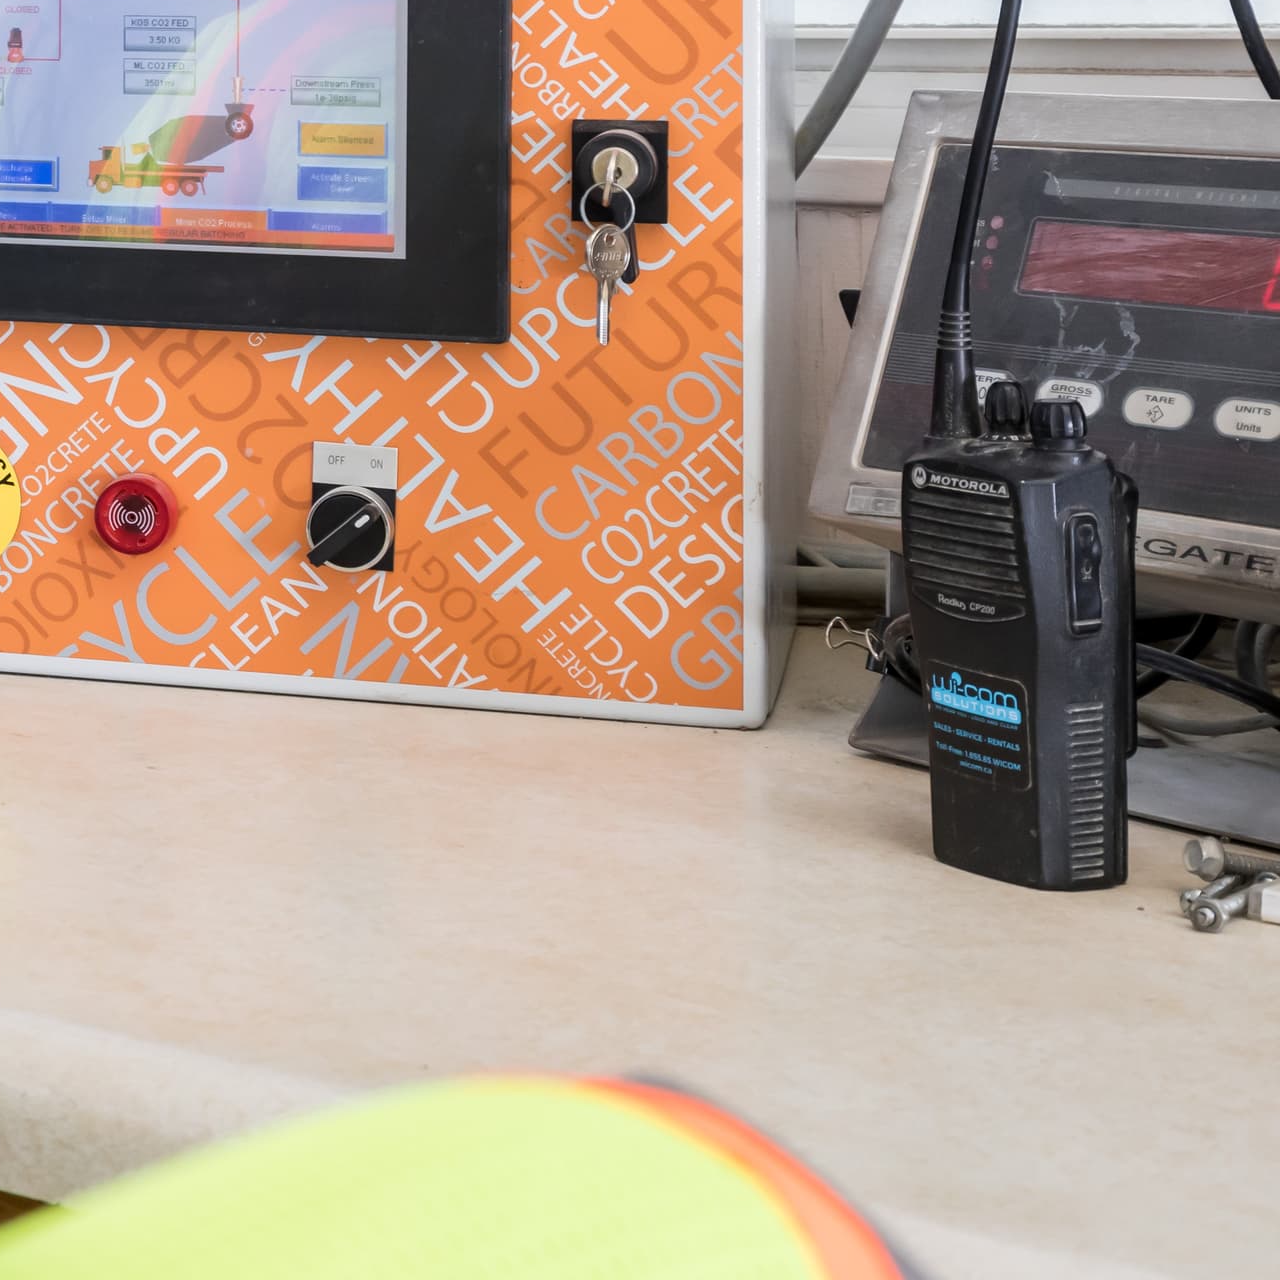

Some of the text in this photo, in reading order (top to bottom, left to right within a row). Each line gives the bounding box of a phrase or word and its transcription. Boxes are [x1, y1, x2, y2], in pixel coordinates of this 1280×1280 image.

[295, 79, 376, 89] Downstream Press
[482, 165, 734, 388] UPCLE
[1051, 383, 1092, 396] GROSS
[1145, 394, 1175, 406] TARE
[1235, 405, 1272, 416] UNITS
[535, 331, 743, 541] CARBON
[1236, 421, 1261, 434] Units
[328, 455, 384, 469] OFF ON
[930, 474, 1007, 495] MOTOROLA
[581, 418, 743, 585] CO2CRETE
[55, 488, 302, 664] YCLE
[938, 593, 966, 610] Radius
[397, 539, 562, 695] NOLOGY
[560, 603, 658, 703] CYCLE
[537, 628, 614, 701] NCRETE
[987, 737, 1021, 752] RENTALS
